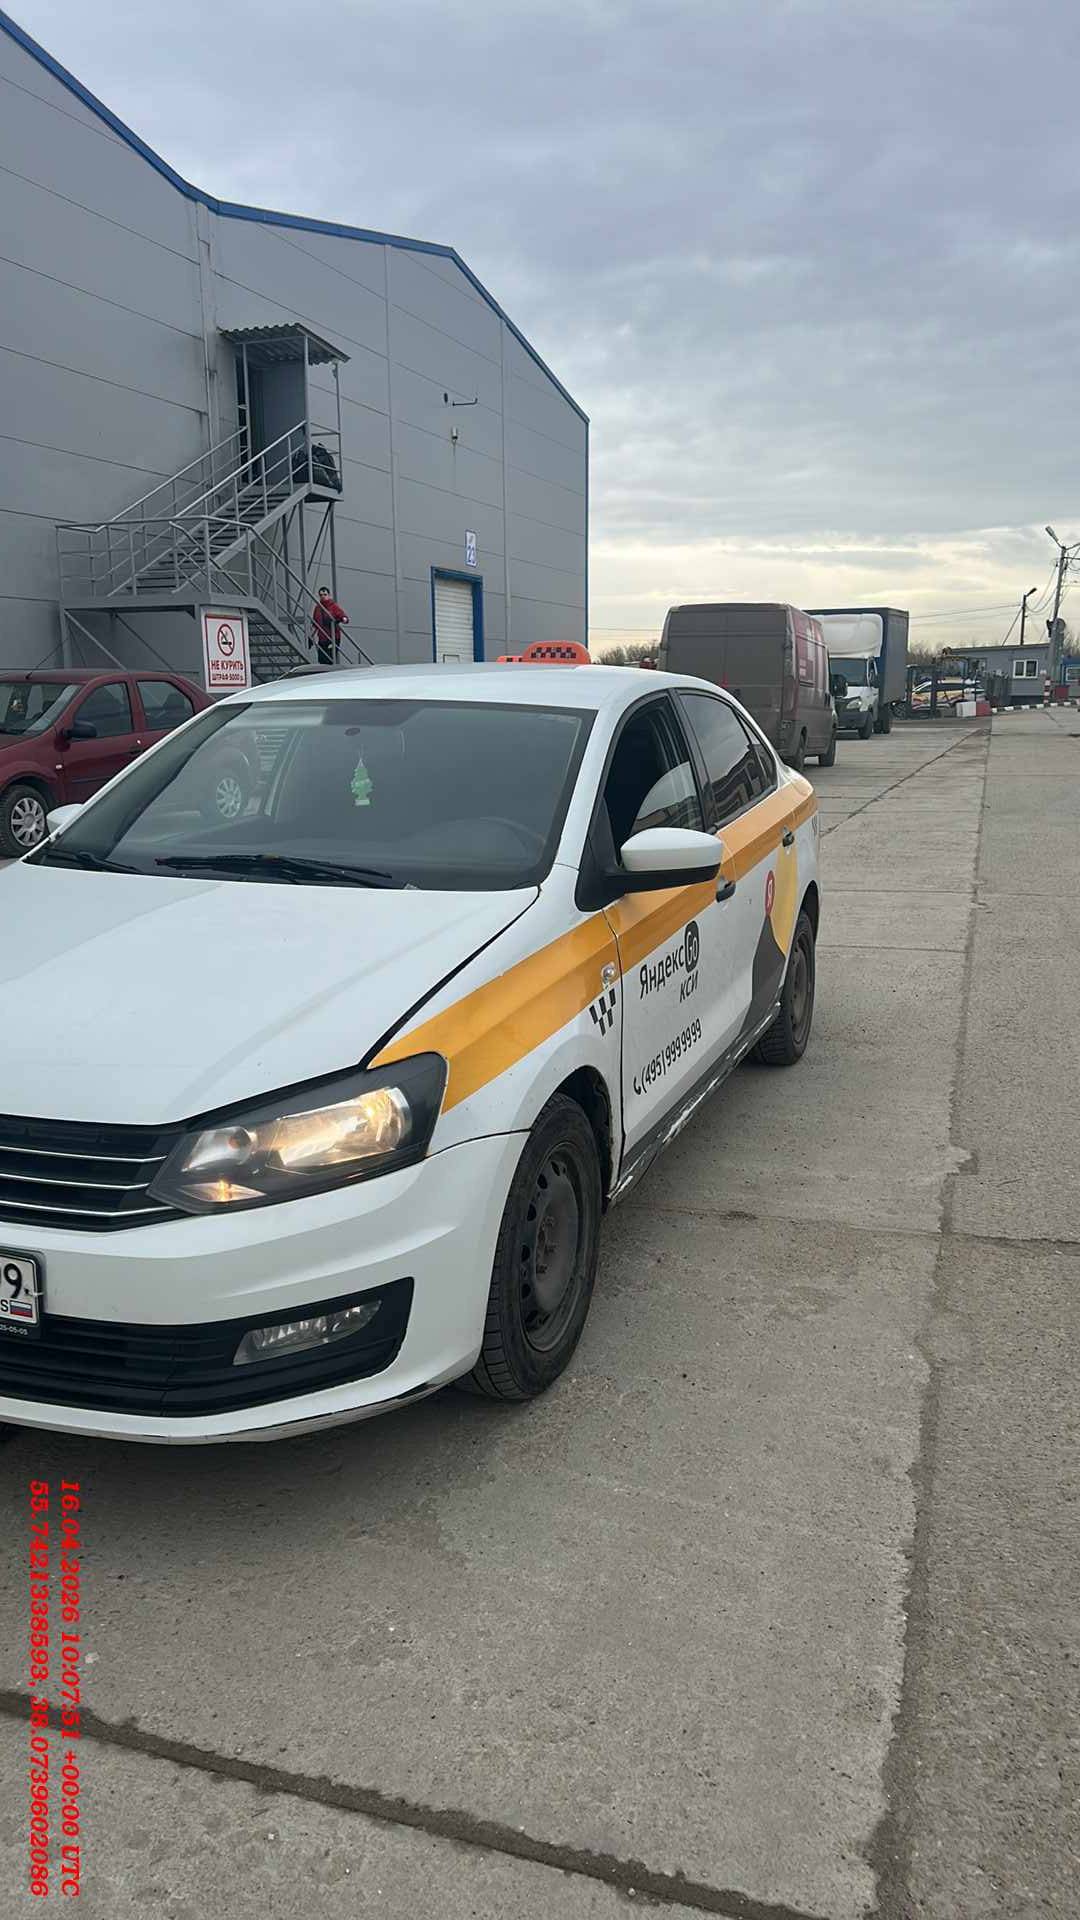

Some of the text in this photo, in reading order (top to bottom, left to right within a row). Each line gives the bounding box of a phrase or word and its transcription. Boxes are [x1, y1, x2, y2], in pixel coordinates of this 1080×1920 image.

[211, 660, 243, 670] НЕ КУРИТЬ
[212, 673, 229, 681] ШТРАФ
[640, 945, 684, 999] Яндекс
[0, 1263, 22, 1299] 9
